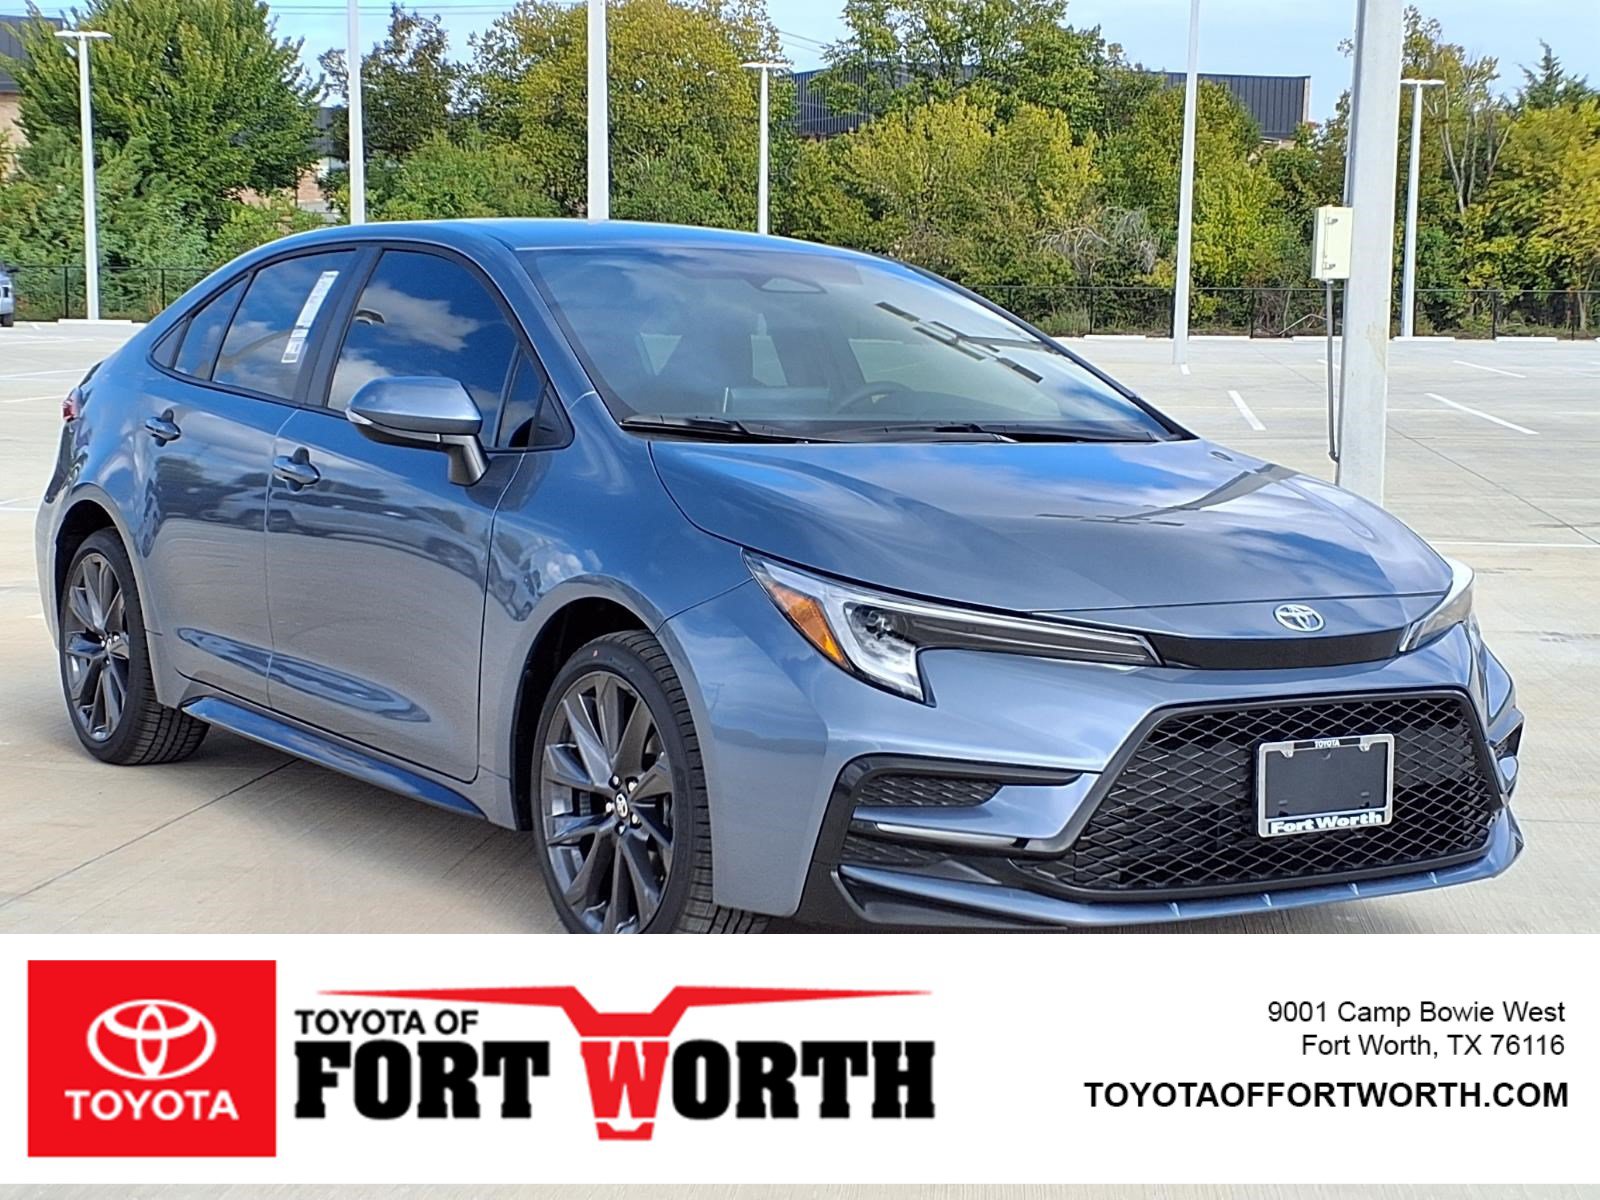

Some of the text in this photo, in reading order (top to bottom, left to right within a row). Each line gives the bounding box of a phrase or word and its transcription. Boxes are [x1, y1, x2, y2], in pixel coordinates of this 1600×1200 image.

[1314, 740, 1340, 749] TOYOTA
[1271, 811, 1382, 834] Fort Worth
